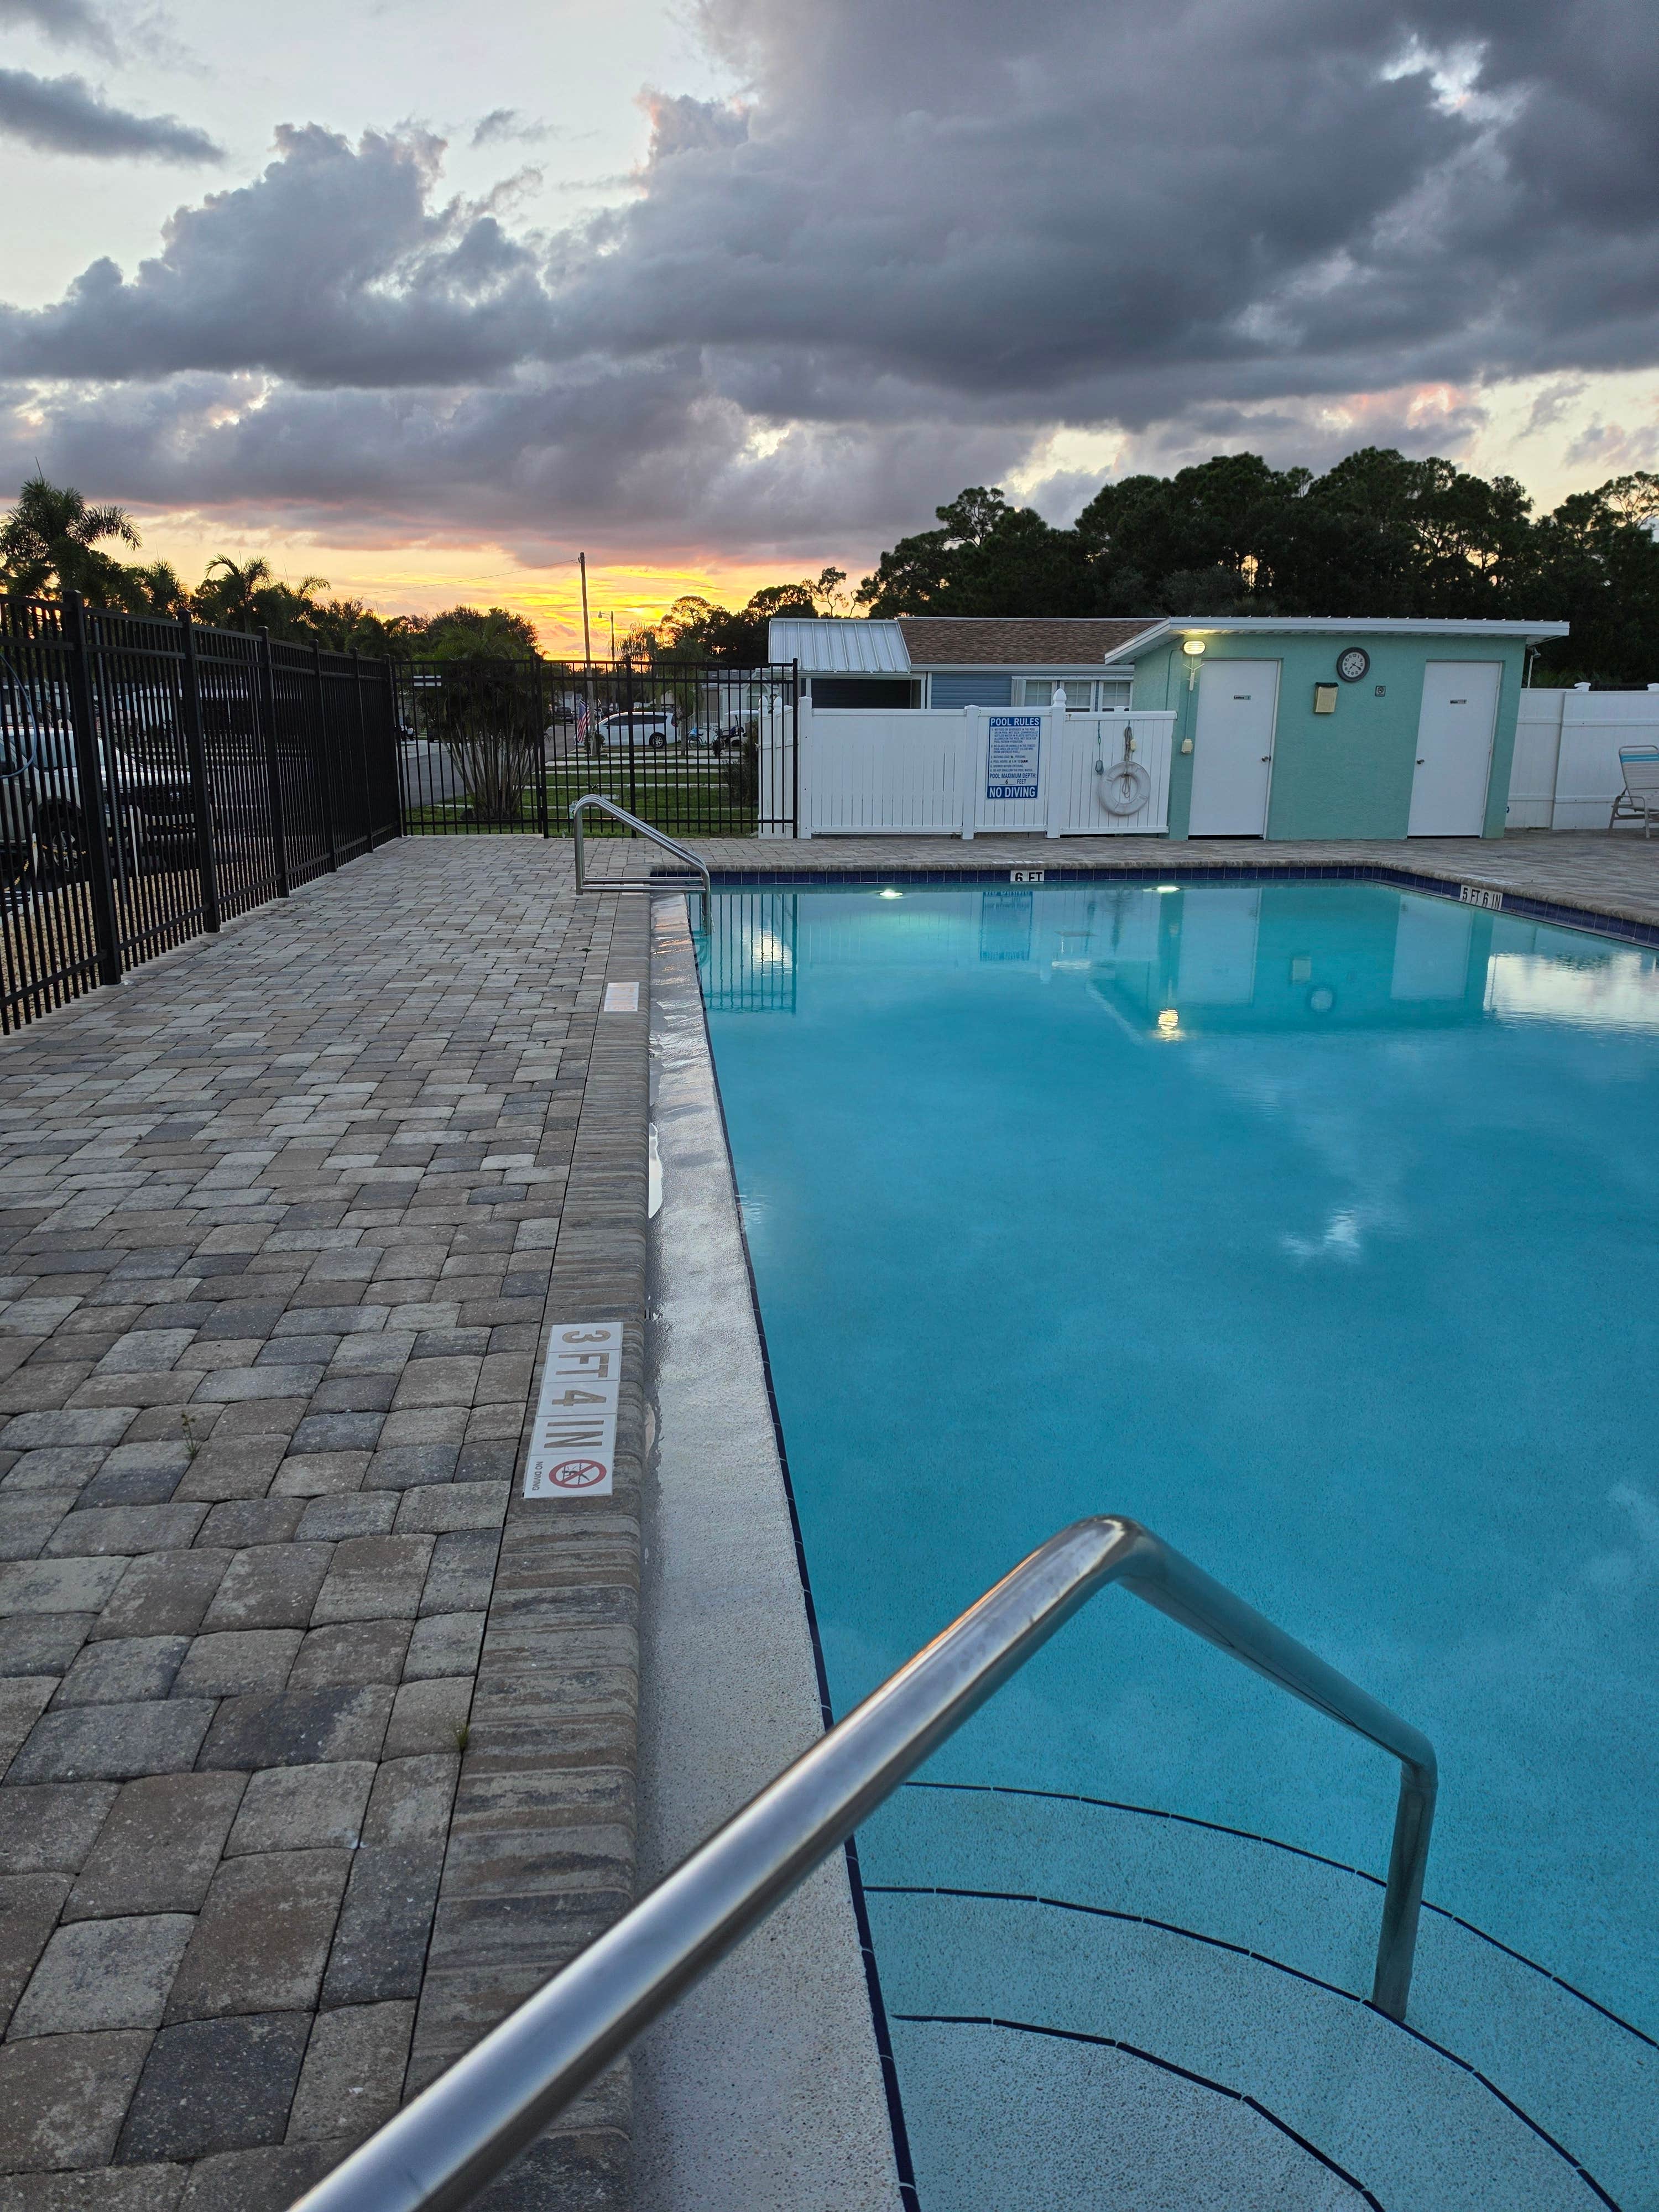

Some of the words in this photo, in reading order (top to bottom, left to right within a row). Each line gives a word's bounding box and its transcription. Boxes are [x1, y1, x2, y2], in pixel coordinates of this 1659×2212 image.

[989, 787, 1002, 797] NO
[1005, 786, 1035, 797] DIVING
[1015, 872, 1023, 881] 6
[1029, 872, 1042, 881] FT
[1462, 887, 1468, 901] 5
[1469, 889, 1480, 905] FT
[1482, 892, 1489, 907] 6
[1491, 893, 1501, 910] IN
[562, 1330, 611, 1344] 3
[555, 1353, 610, 1378] FT
[552, 1390, 607, 1407] 4
[544, 1420, 604, 1449] IN
[535, 1461, 543, 1470] NO
[531, 1471, 542, 1491] DIVING
